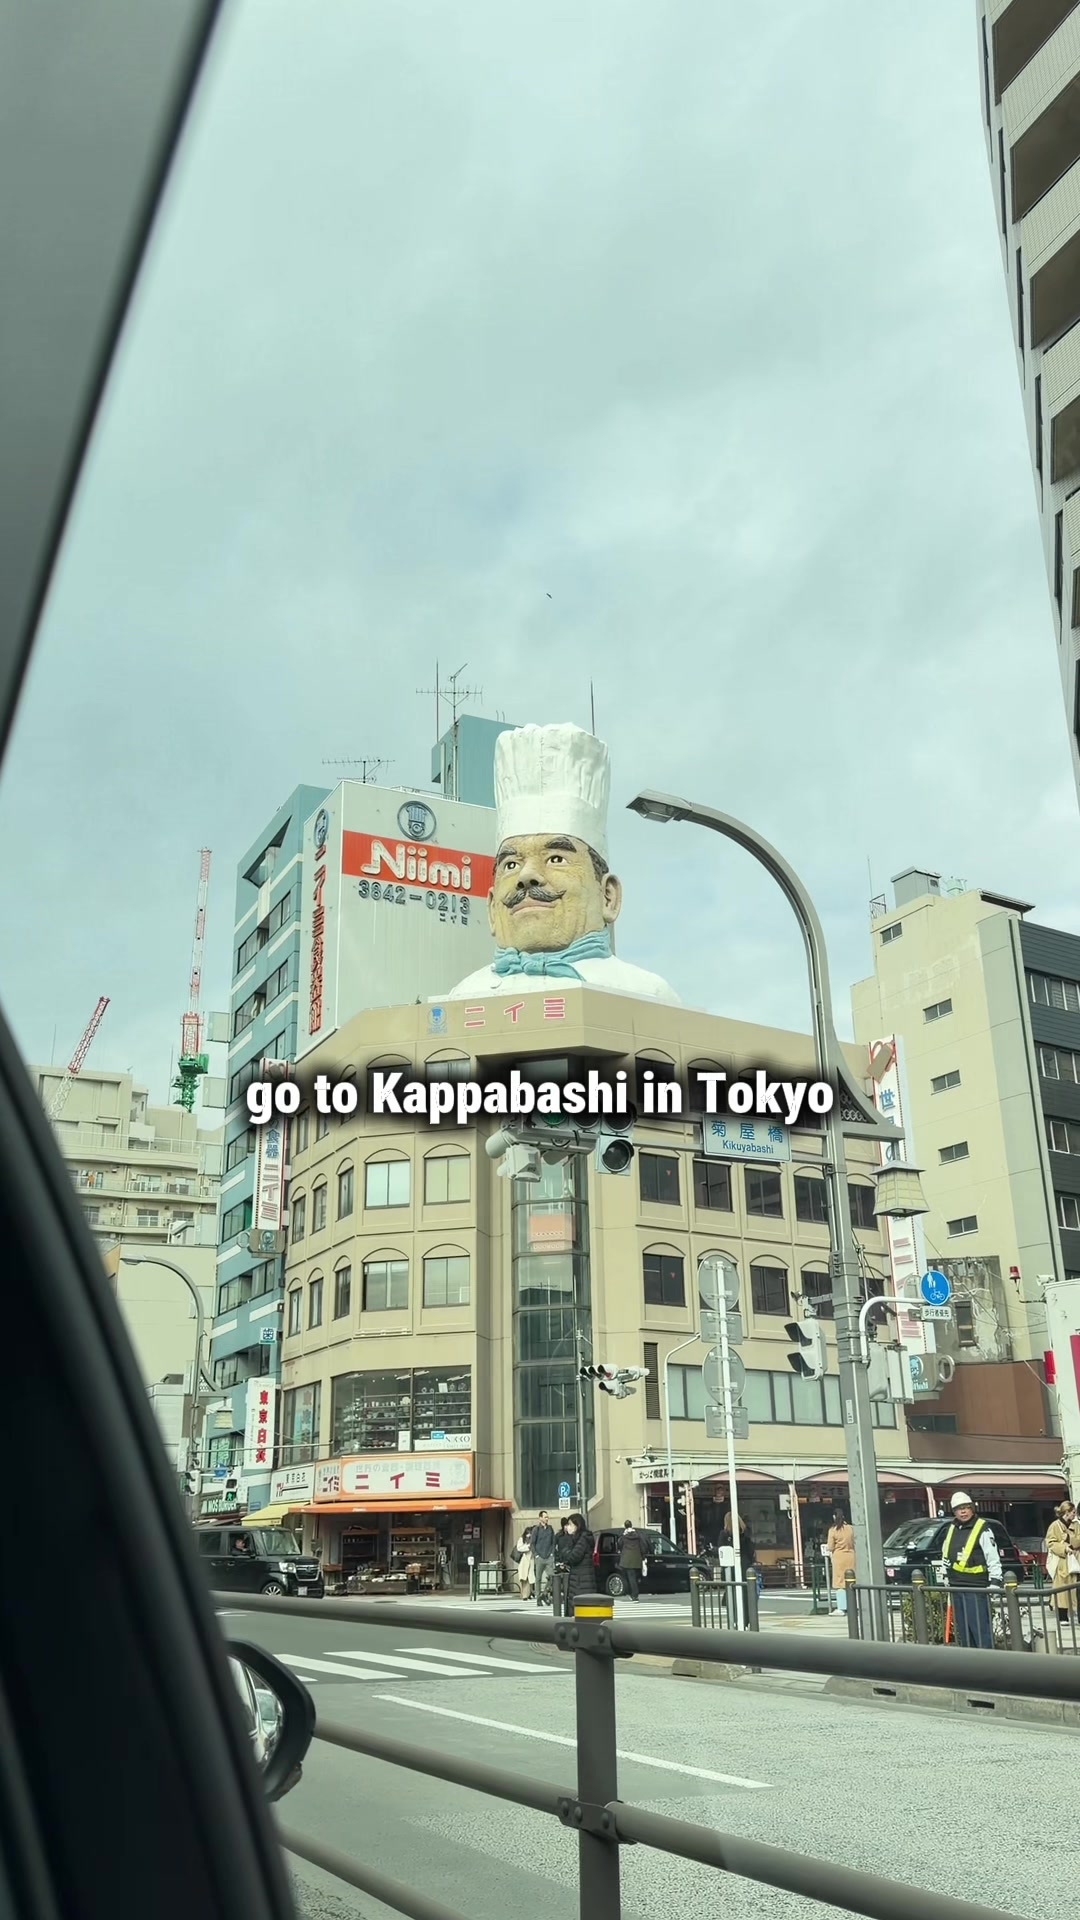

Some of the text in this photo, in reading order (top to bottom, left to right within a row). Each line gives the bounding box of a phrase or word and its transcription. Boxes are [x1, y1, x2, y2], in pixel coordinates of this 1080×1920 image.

[360, 839, 472, 890] Niimi
[465, 998, 565, 1027] ニイミ
[711, 1120, 783, 1143] 菊屋橋
[722, 1139, 774, 1154] Kikuyabashi
[261, 1163, 280, 1221] ニイミ
[256, 1389, 269, 1464] 東京白衣
[355, 1472, 441, 1490] ニイミ
